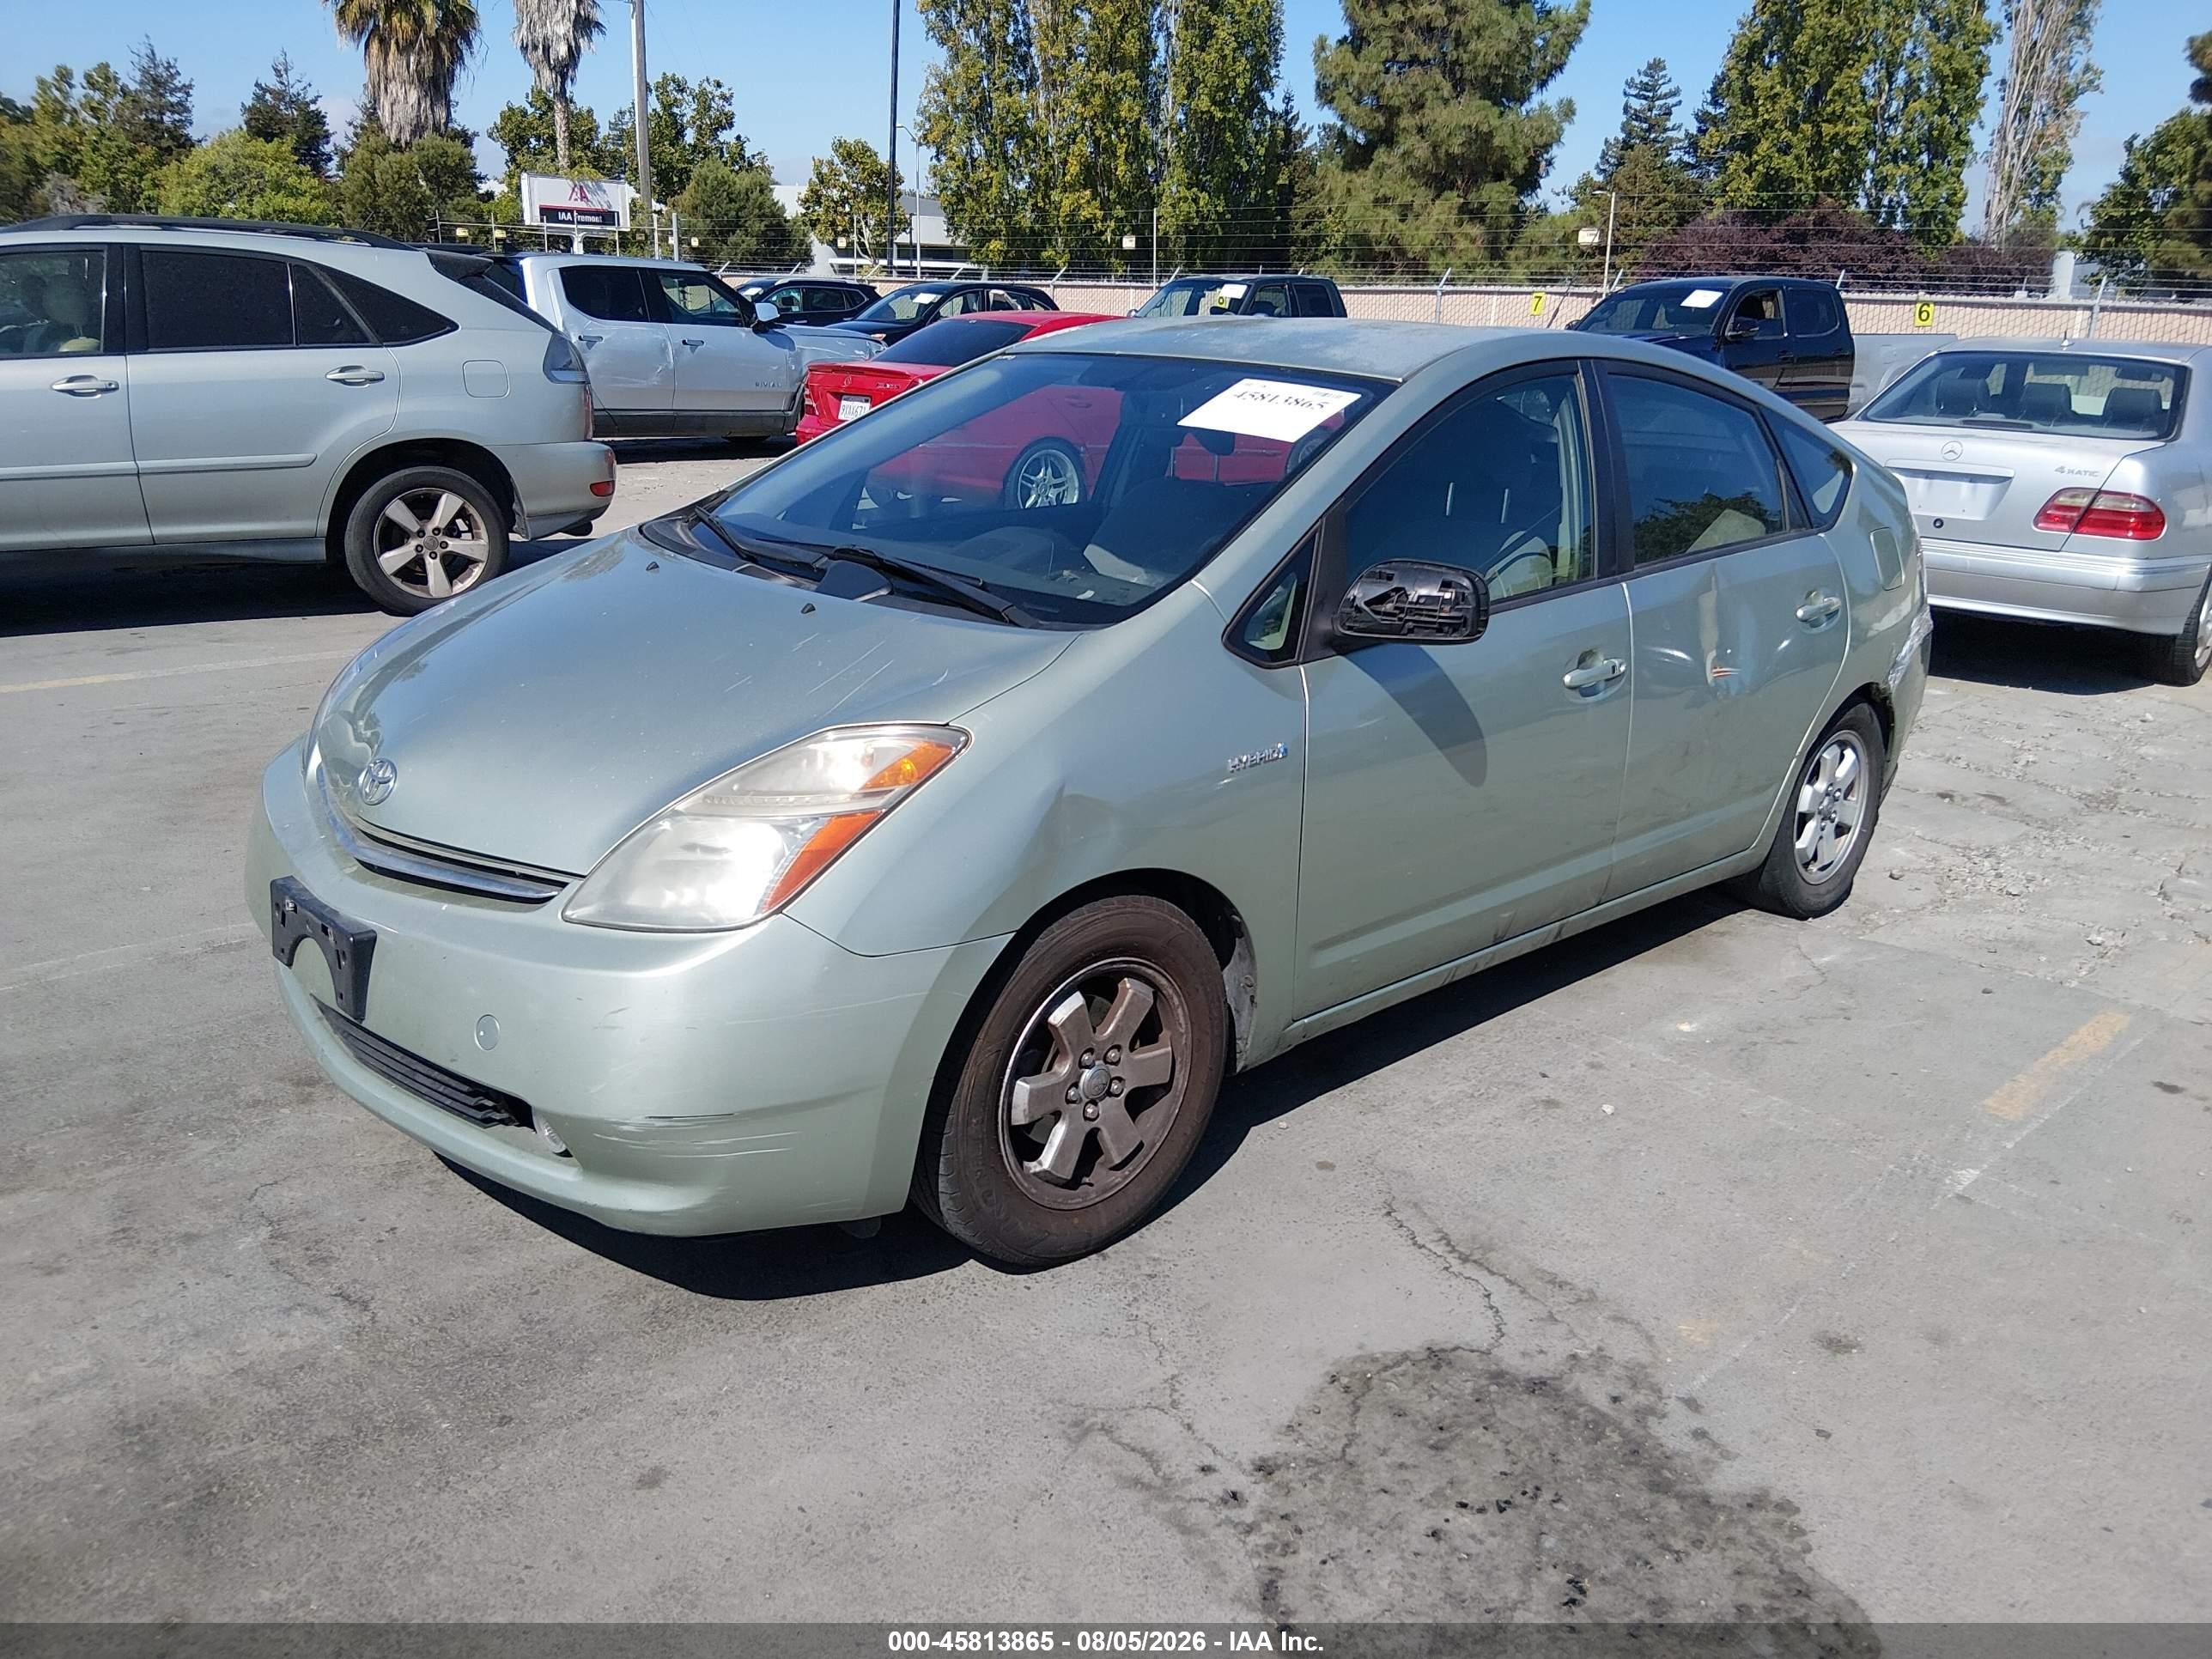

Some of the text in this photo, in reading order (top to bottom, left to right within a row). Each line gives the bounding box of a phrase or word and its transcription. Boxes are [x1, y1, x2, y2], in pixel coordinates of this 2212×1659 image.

[558, 211, 573, 222] IAA
[1534, 295, 1543, 312] 7
[1917, 302, 1930, 322] 6
